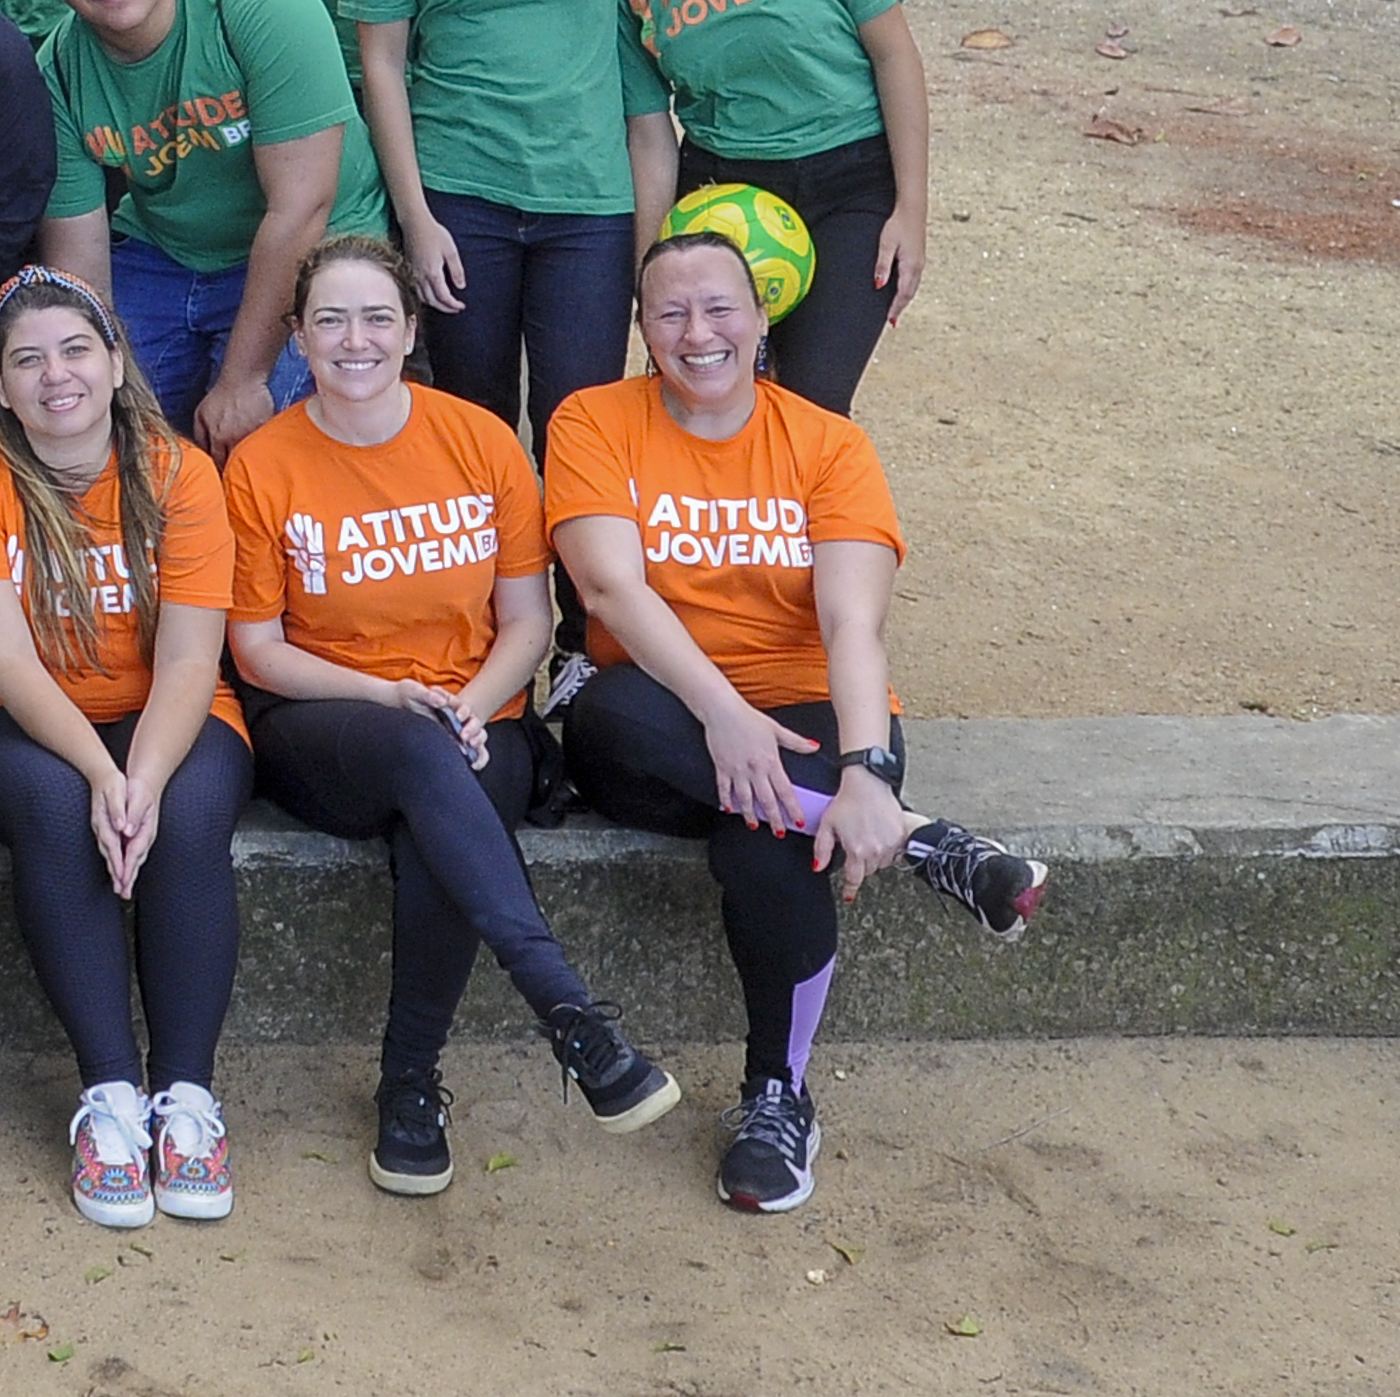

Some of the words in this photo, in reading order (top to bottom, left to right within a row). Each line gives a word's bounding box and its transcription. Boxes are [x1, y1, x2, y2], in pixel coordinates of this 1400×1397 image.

[647, 493, 807, 534] ATITUD
[341, 533, 478, 585] JOVEM
[646, 530, 791, 568] JOVEM
